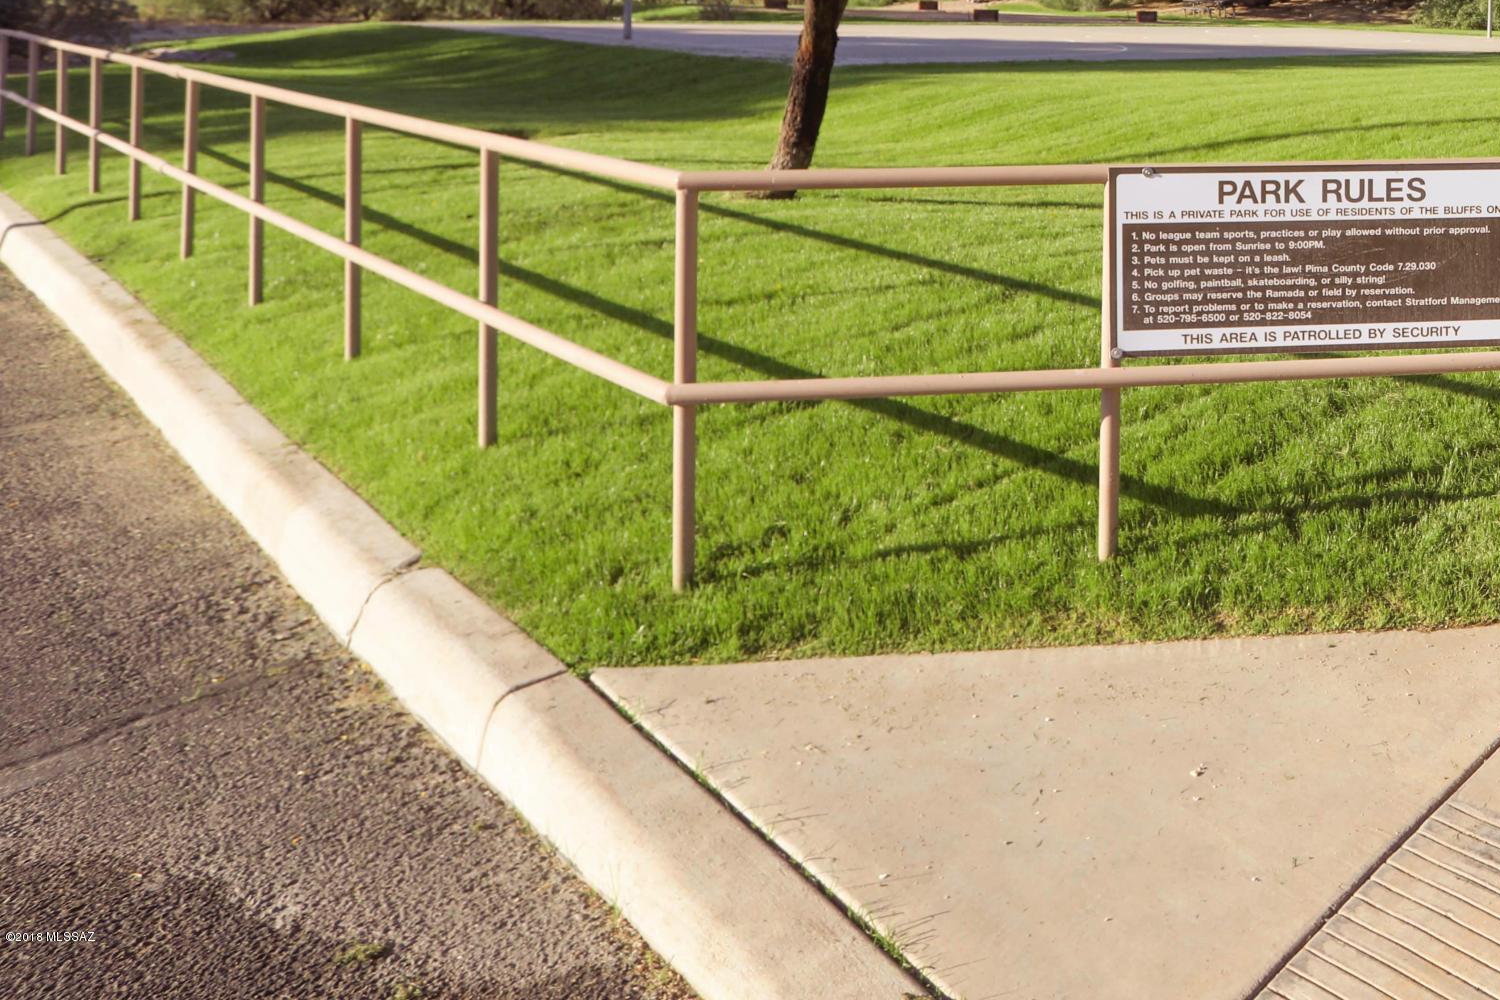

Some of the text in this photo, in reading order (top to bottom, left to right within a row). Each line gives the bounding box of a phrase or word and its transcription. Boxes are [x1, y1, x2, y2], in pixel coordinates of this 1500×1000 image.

[1217, 177, 1426, 204] PARK RULES
[1124, 211, 1148, 220] THIS
[1153, 211, 1164, 219] IS
[1169, 211, 1176, 219] A
[1181, 209, 1225, 219] PRIVATE
[1229, 209, 1259, 218] PARK
[1264, 209, 1286, 218] FOR
[1290, 208, 1312, 217] USE
[1317, 208, 1331, 217] OF
[1335, 206, 1395, 216] RESIDENTS
[1400, 206, 1414, 215] OF
[1420, 206, 1439, 215] THE
[1443, 205, 1482, 214] BLUFFS
[1131, 232, 1138, 240] 1.
[1142, 231, 1156, 240] No
[1159, 230, 1191, 241] league
[1195, 230, 1220, 239] team
[1223, 229, 1257, 240] sports,
[1260, 228, 1305, 239] practices
[1322, 228, 1342, 238] play
[1345, 227, 1381, 236] allowed
[1385, 226, 1419, 235] without
[1423, 226, 1445, 236] prior
[1448, 225, 1490, 235] approval.
[1131, 240, 1325, 253] 2. Park is open from Sunrise to 9:00PM.
[1131, 256, 1140, 265] 3.
[1144, 256, 1165, 265] Pets
[1169, 255, 1193, 264] must
[1197, 254, 1209, 263] be
[1213, 254, 1234, 264] kept
[1238, 254, 1250, 263] on
[1264, 253, 1291, 262] leash.
[1131, 268, 1140, 277] 4.
[1144, 267, 1164, 277] Pick
[1168, 268, 1180, 278] up
[1184, 267, 1200, 277] pet
[1204, 267, 1233, 275] waste
[1245, 265, 1260, 274] it's
[1264, 265, 1279, 274] the
[1282, 264, 1301, 274] law!
[1305, 264, 1328, 273] Pima
[1332, 263, 1366, 274] County
[1369, 263, 1394, 272] Code
[1397, 262, 1437, 271] 7.29.030
[1131, 281, 1140, 289] 5.
[1144, 280, 1158, 289] No
[1161, 279, 1197, 290] golfing,
[1200, 278, 1244, 289] paintball,
[1247, 277, 1317, 288] skateboarding,
[1334, 275, 1353, 285] silly
[1356, 274, 1386, 285] string!
[1131, 293, 1141, 302] 6.
[1144, 292, 1179, 302] Groups
[1183, 293, 1203, 302] may
[1207, 291, 1243, 299] reserve
[1246, 290, 1262, 299] the
[1266, 289, 1305, 298] Ramada
[1322, 288, 1342, 296] field
[1345, 287, 1357, 297] by
[1360, 286, 1415, 295] reservation.
[1132, 305, 1140, 314] 7.
[1143, 305, 1156, 314] To
[1159, 304, 1189, 315] report
[1193, 302, 1237, 313] problems
[1254, 302, 1264, 310] to
[1268, 301, 1294, 310] make
[1307, 299, 1362, 309] reservation,
[1366, 298, 1402, 307] contact
[1405, 297, 1447, 306] Stratford
[1143, 311, 1312, 324] at 520-795-6500 or 520-822-8054
[1181, 325, 1461, 344] THIS AREA IS PATROLLED BY SECURITY
